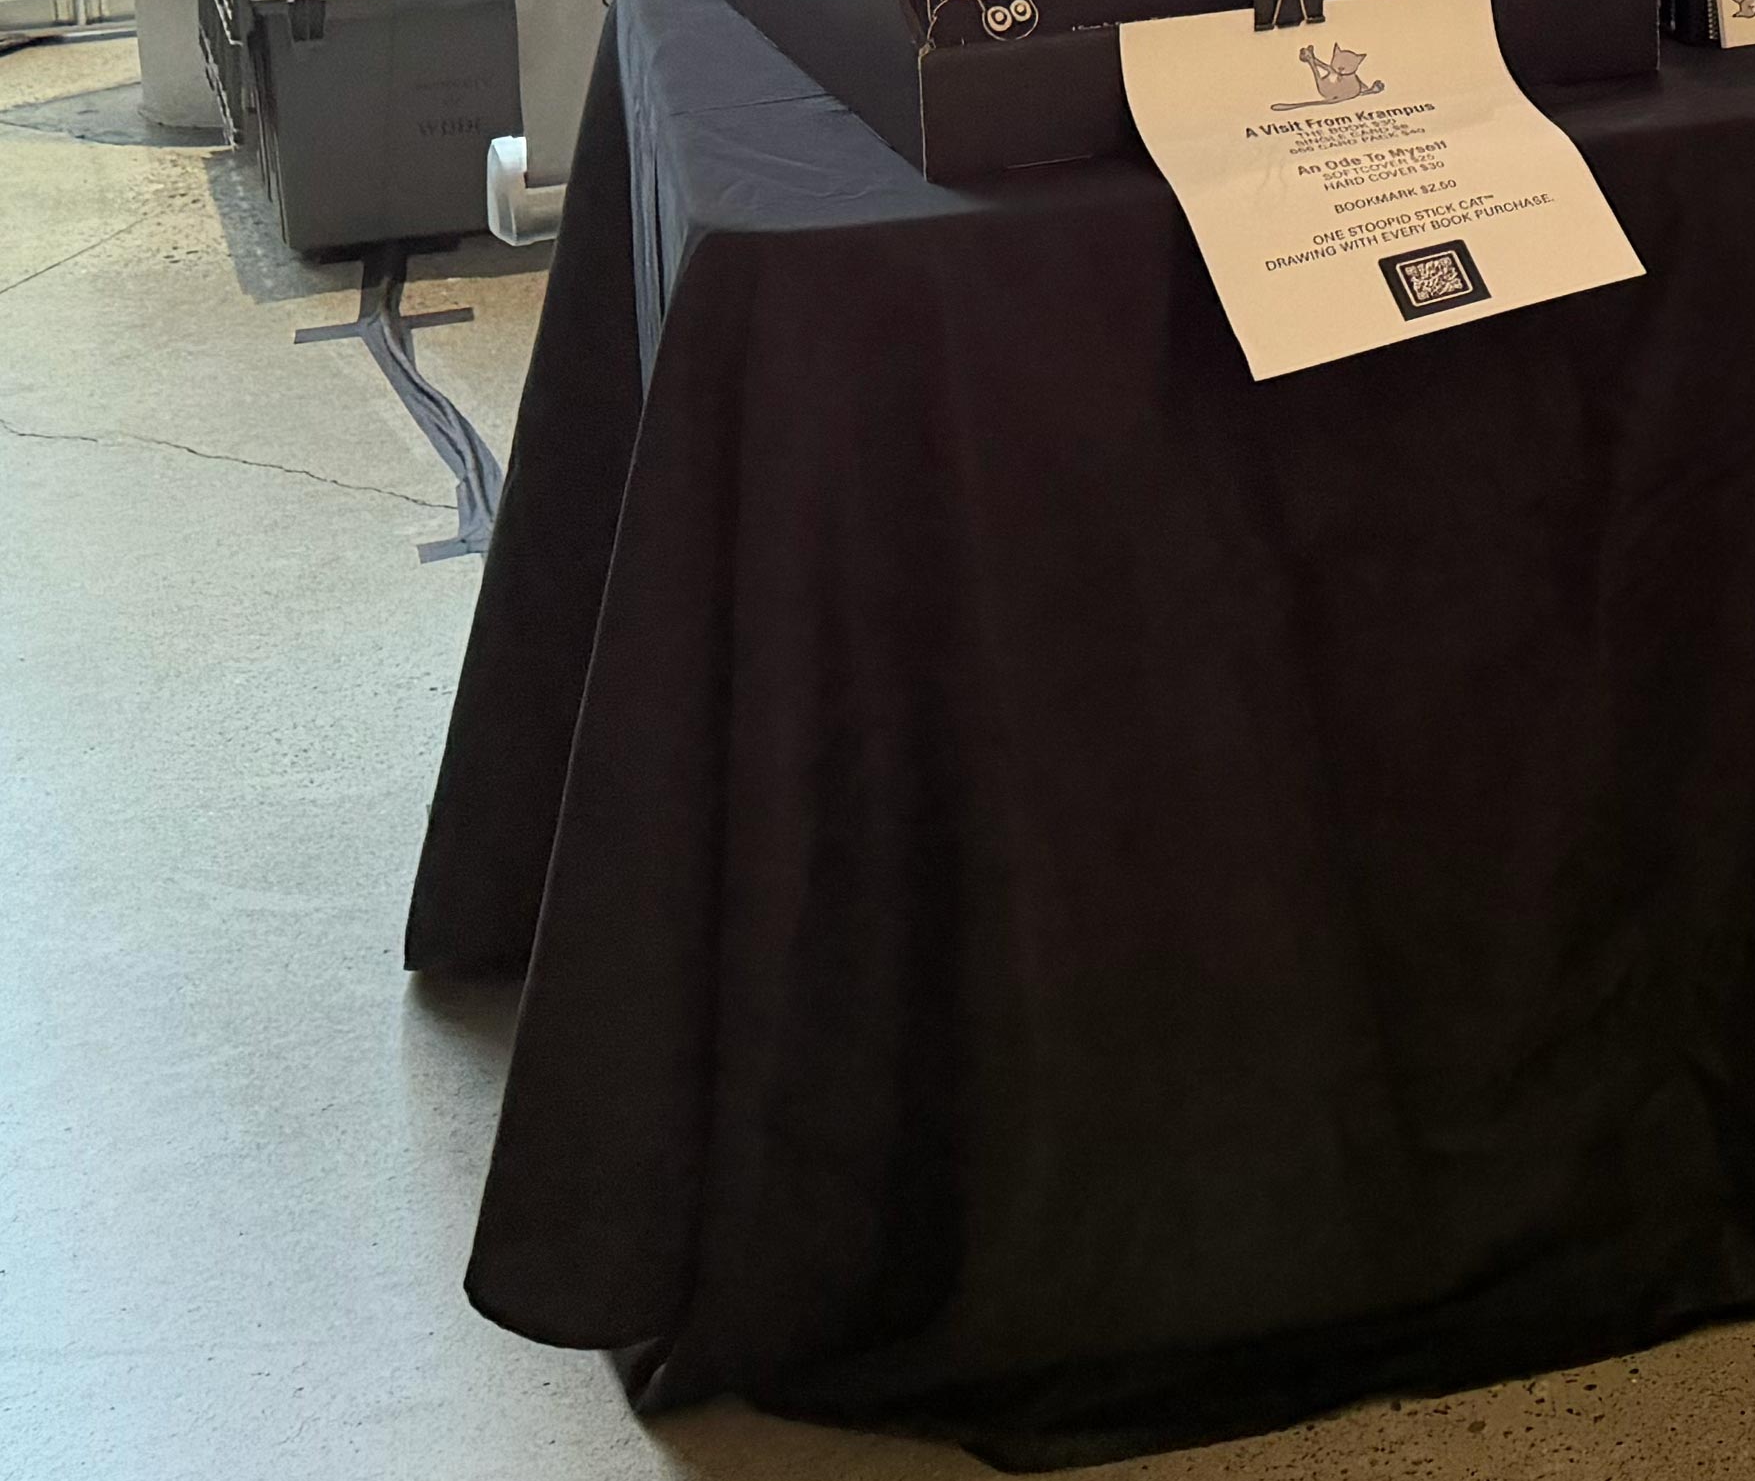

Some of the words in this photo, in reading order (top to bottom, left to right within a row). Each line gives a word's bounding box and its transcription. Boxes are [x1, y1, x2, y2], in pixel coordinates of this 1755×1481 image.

[1245, 127, 1258, 139] A
[1259, 120, 1301, 136] Visit
[1306, 114, 1353, 130] From
[1354, 103, 1436, 121] Krampus
[1325, 123, 1368, 137] BOOK
[1297, 164, 1322, 176] An
[1325, 156, 1362, 170] Ode
[1365, 152, 1386, 164] To
[1389, 140, 1448, 160] Myself
[1323, 157, 1408, 181] SOFTCOVER
[1324, 175, 1365, 191] HARD
[1368, 165, 1418, 183] COVER
[1420, 160, 1445, 172] $30
[1334, 187, 1418, 214] BOOKMARK
[1420, 179, 1457, 195] $2.50
[1312, 228, 1345, 246] ONE
[1347, 214, 1411, 237] STOOPID
[1414, 203, 1456, 221] STICK
[1265, 245, 1337, 272] DRAWING
[1339, 234, 1378, 253] WITH
[1382, 224, 1427, 243] EVERY
[1430, 213, 1472, 231] BOOK
